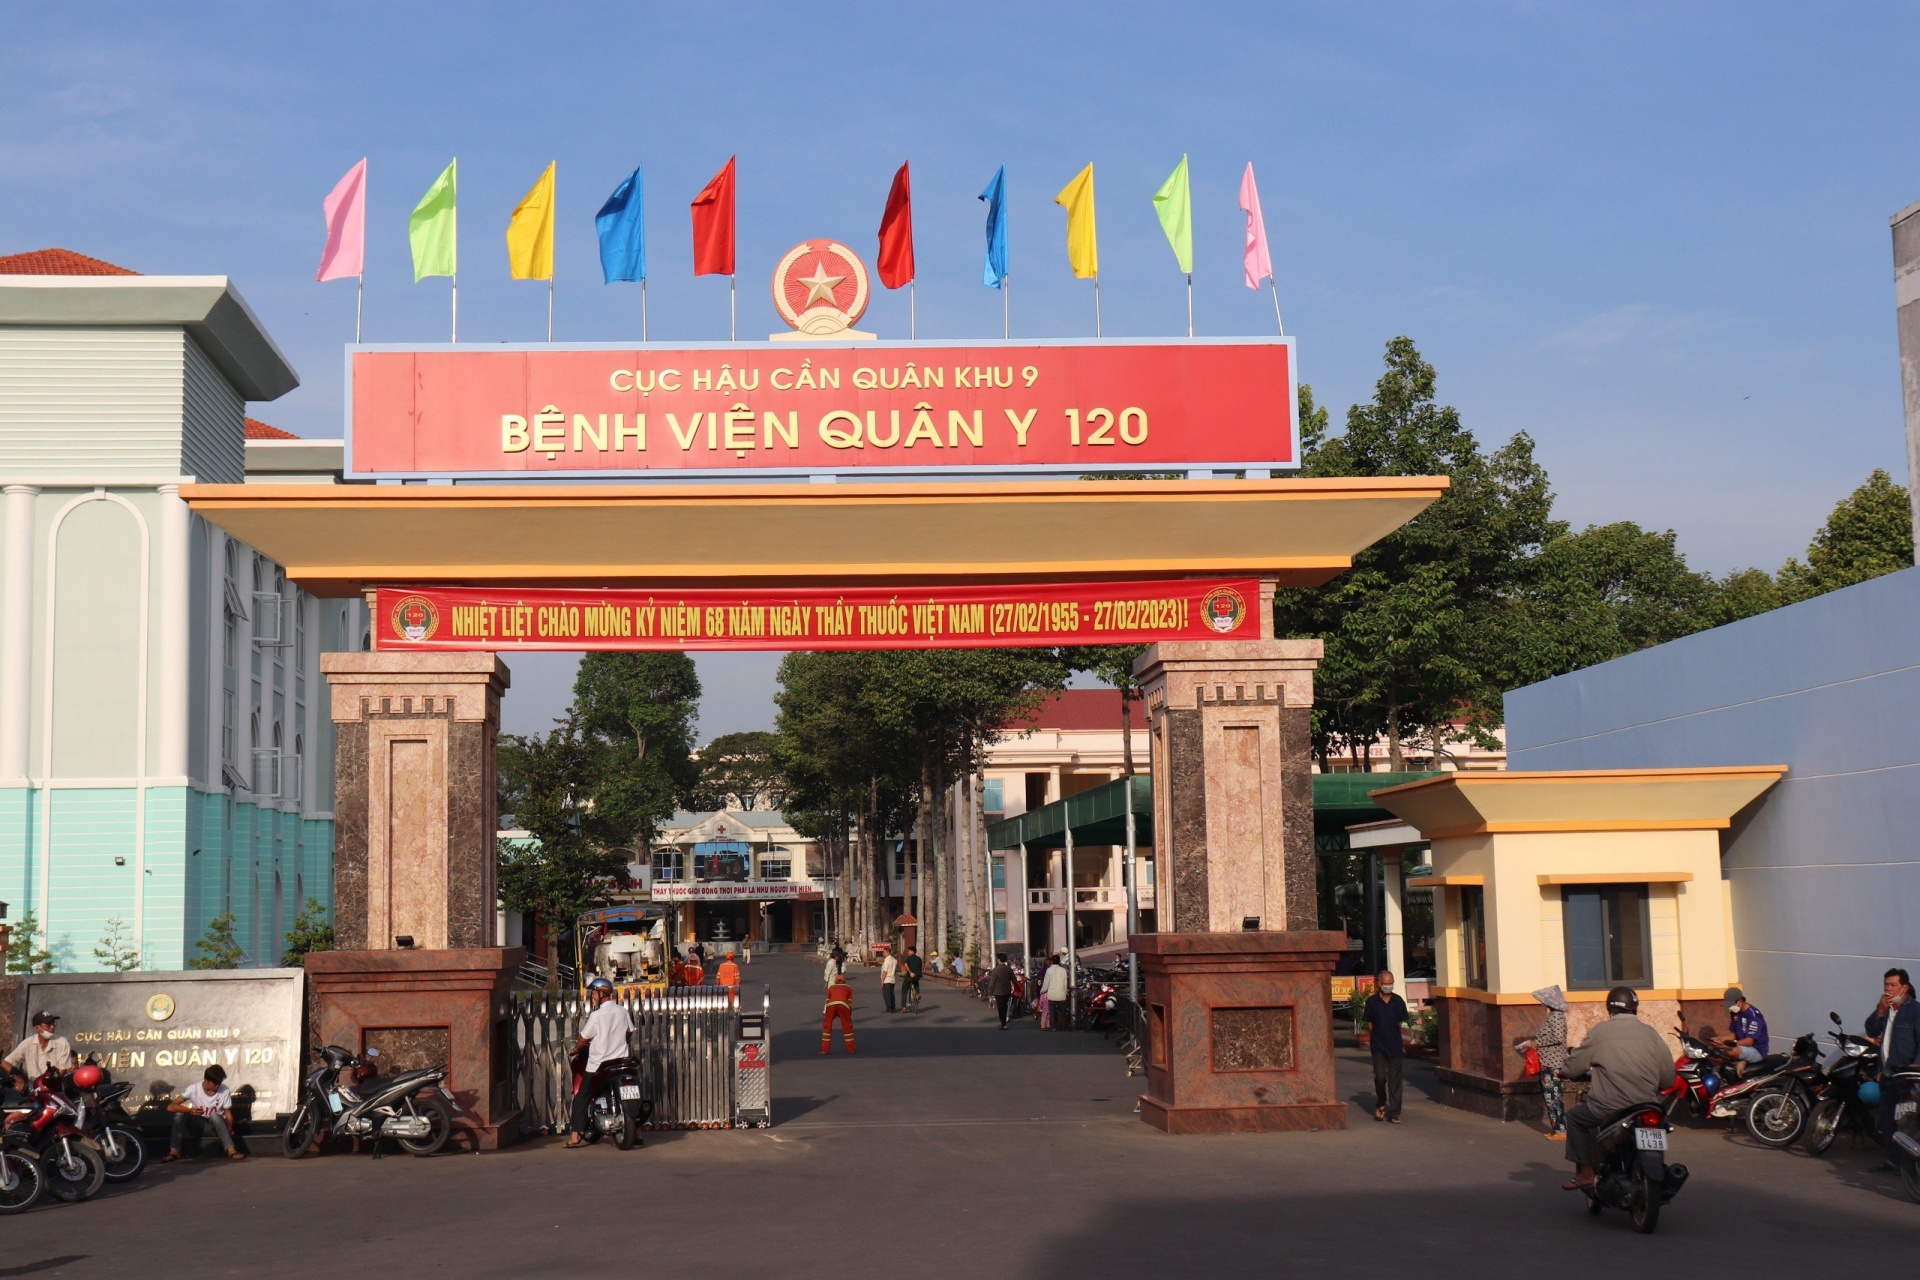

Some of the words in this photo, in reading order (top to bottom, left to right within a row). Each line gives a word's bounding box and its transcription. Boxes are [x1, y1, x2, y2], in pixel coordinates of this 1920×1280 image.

[610, 369, 682, 397] CỤC
[693, 364, 760, 396] HẬU
[770, 358, 840, 391] CẦN
[852, 363, 944, 391] QUÂN
[955, 366, 1013, 388] KHU
[1022, 366, 1039, 388] 9
[501, 404, 647, 460] BỆNH
[665, 402, 799, 458] VIỆN
[819, 401, 983, 449] QUÂN
[1004, 409, 1039, 446] Y
[1065, 407, 1149, 446] 120
[452, 600, 497, 643] NHIỆT
[502, 600, 533, 643] LIỆT
[538, 601, 580, 637] CHÀO
[584, 600, 631, 637] MỪNG
[660, 600, 701, 643] NIỆM
[705, 607, 725, 637] 68
[729, 600, 765, 637] NĂM
[770, 600, 811, 636] NGÀY
[815, 596, 854, 636] THẦY
[858, 595, 908, 636] THUỐC
[912, 598, 945, 641] VIỆT
[949, 603, 985, 634] NAM
[990, 602, 1078, 637] (27/02/1955
[1094, 598, 1188, 632] 27/02/2023)!
[75, 1032, 102, 1044] CỤC
[107, 1029, 132, 1043] HẬU
[167, 1028, 201, 1040] QUÂN
[206, 1028, 228, 1039] KHU
[233, 1028, 240, 1038] 9
[97, 1047, 146, 1073] VIỆN
[155, 1046, 217, 1067] QUÂN
[224, 1048, 239, 1065] Y
[244, 1047, 274, 1064] 120
